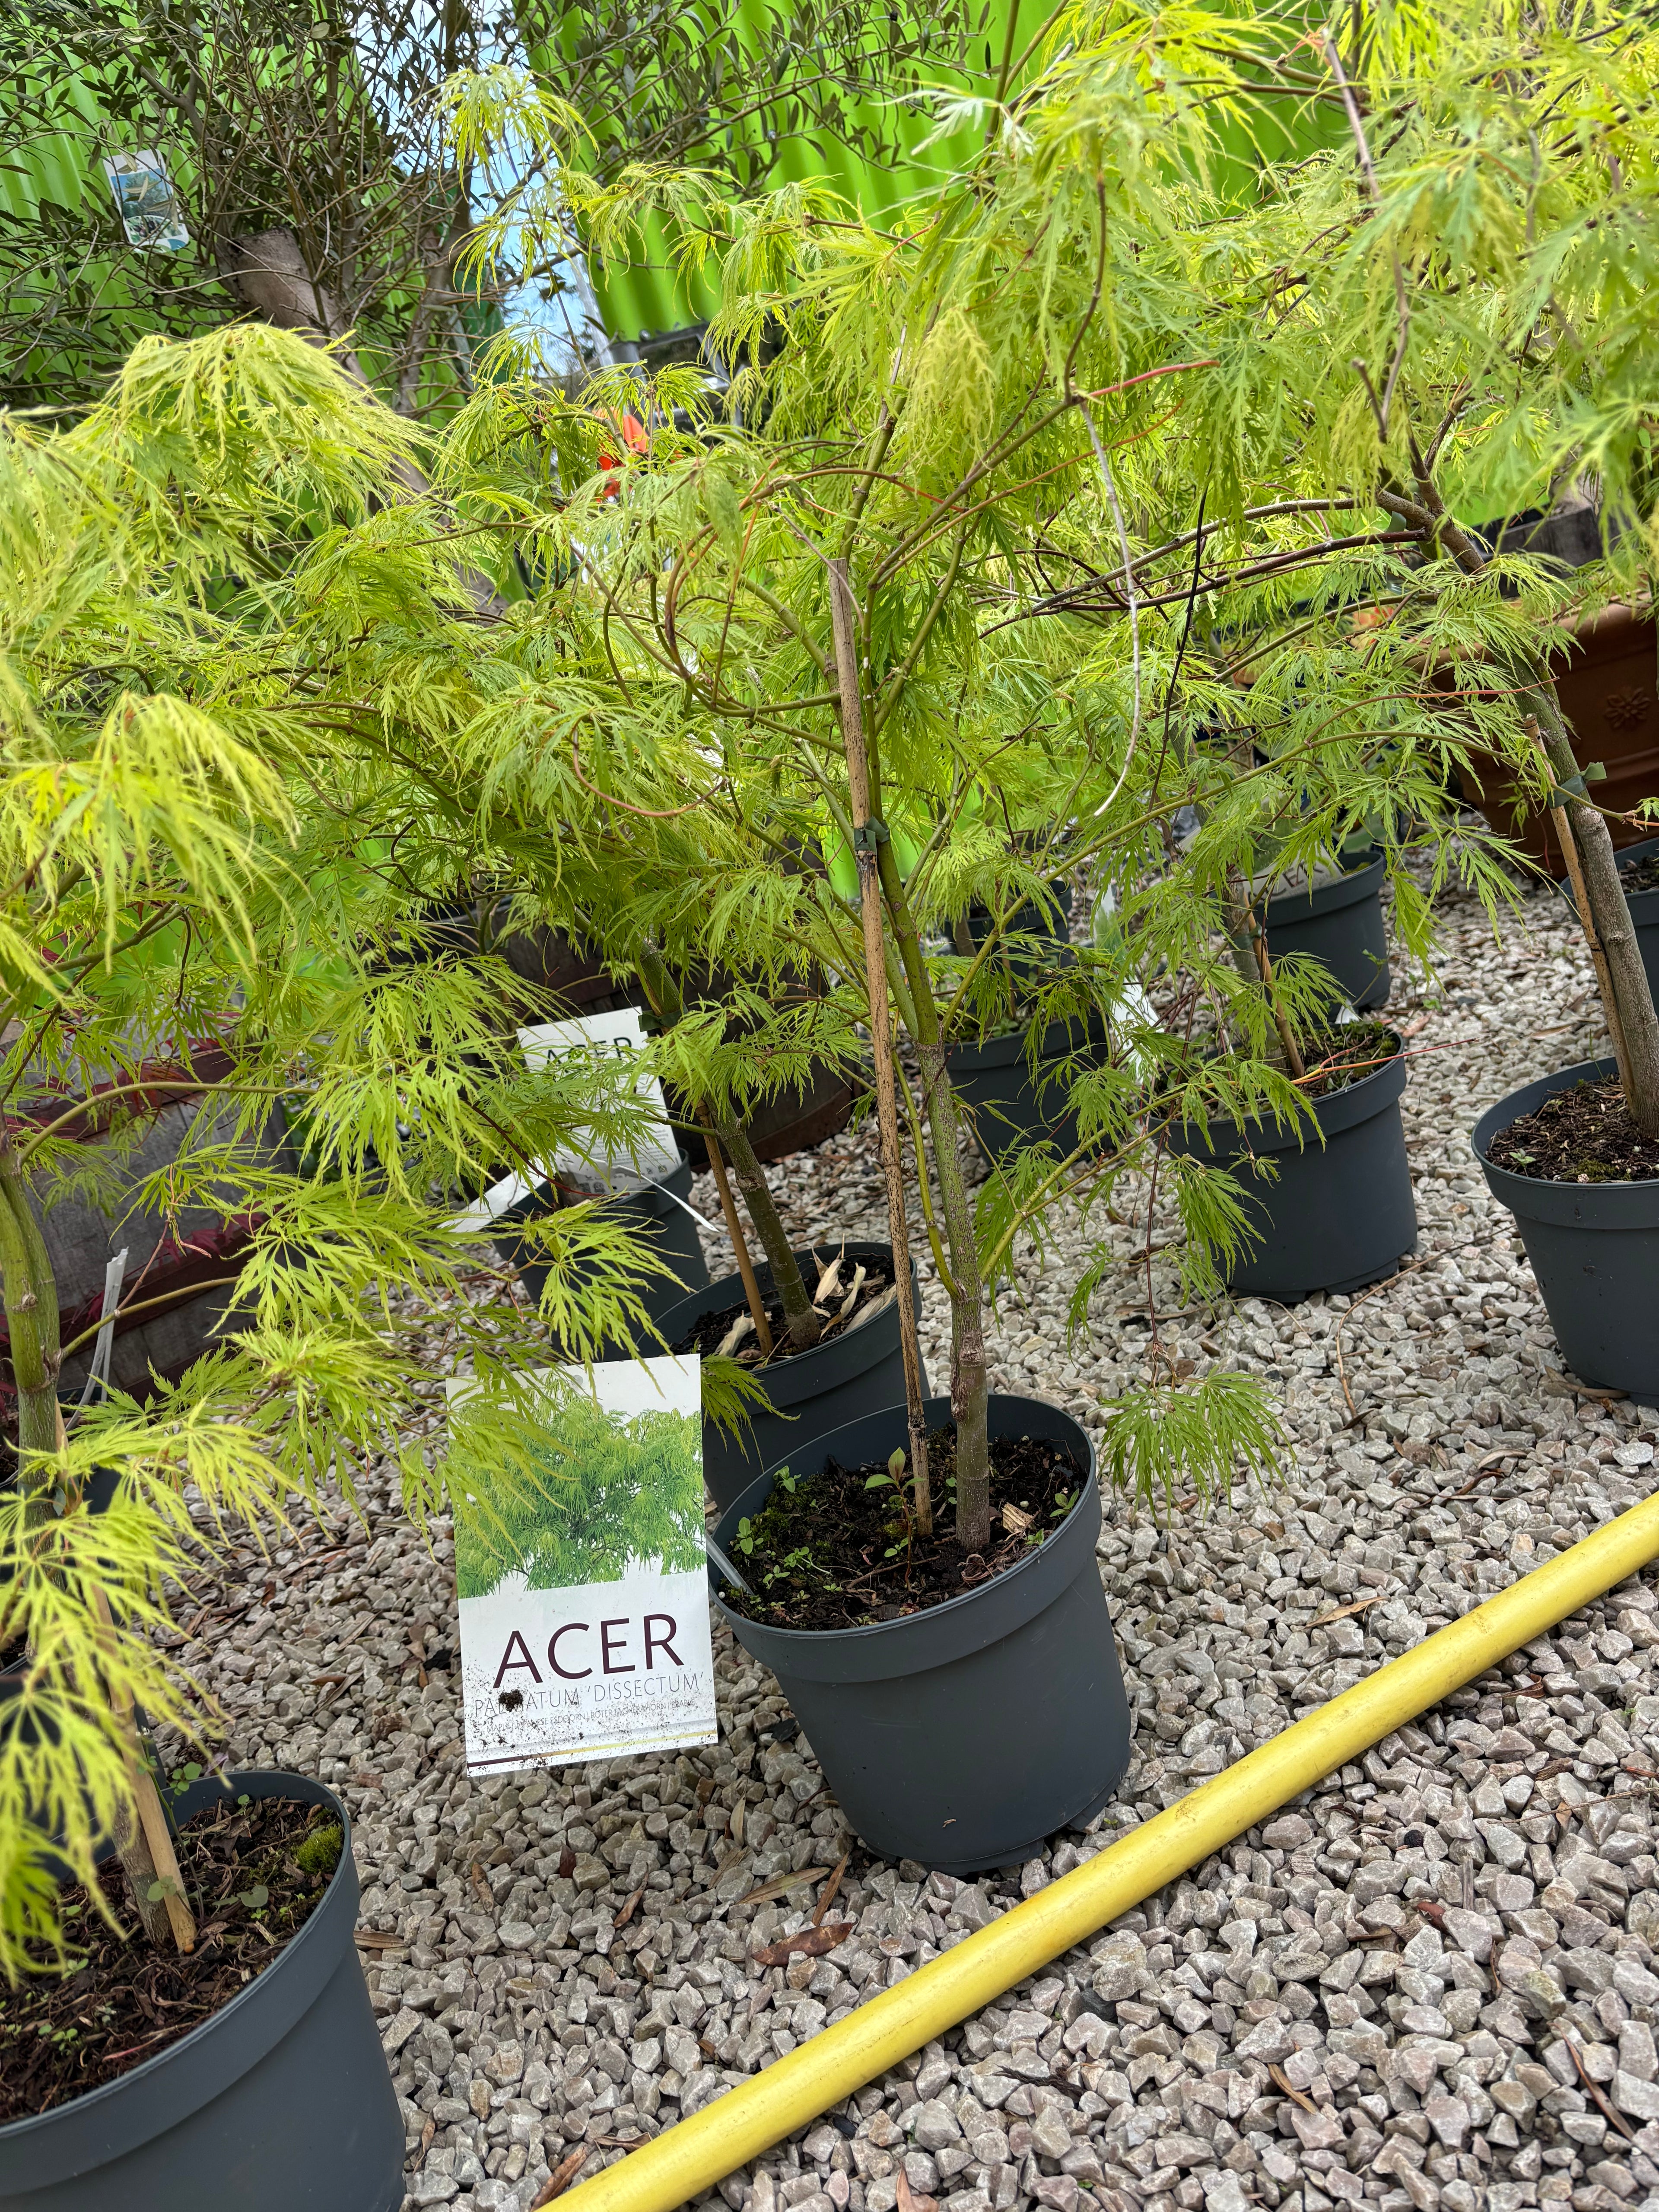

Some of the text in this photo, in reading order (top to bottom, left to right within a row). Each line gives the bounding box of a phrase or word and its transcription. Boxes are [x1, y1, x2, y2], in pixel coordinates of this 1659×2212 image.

[493, 1614, 684, 1689] ACER
[486, 1722, 512, 1732] MAPLE
[515, 1718, 548, 1729] JAPANESE
[550, 1713, 585, 1724] ESDOORN
[591, 1710, 613, 1719] ROTER
